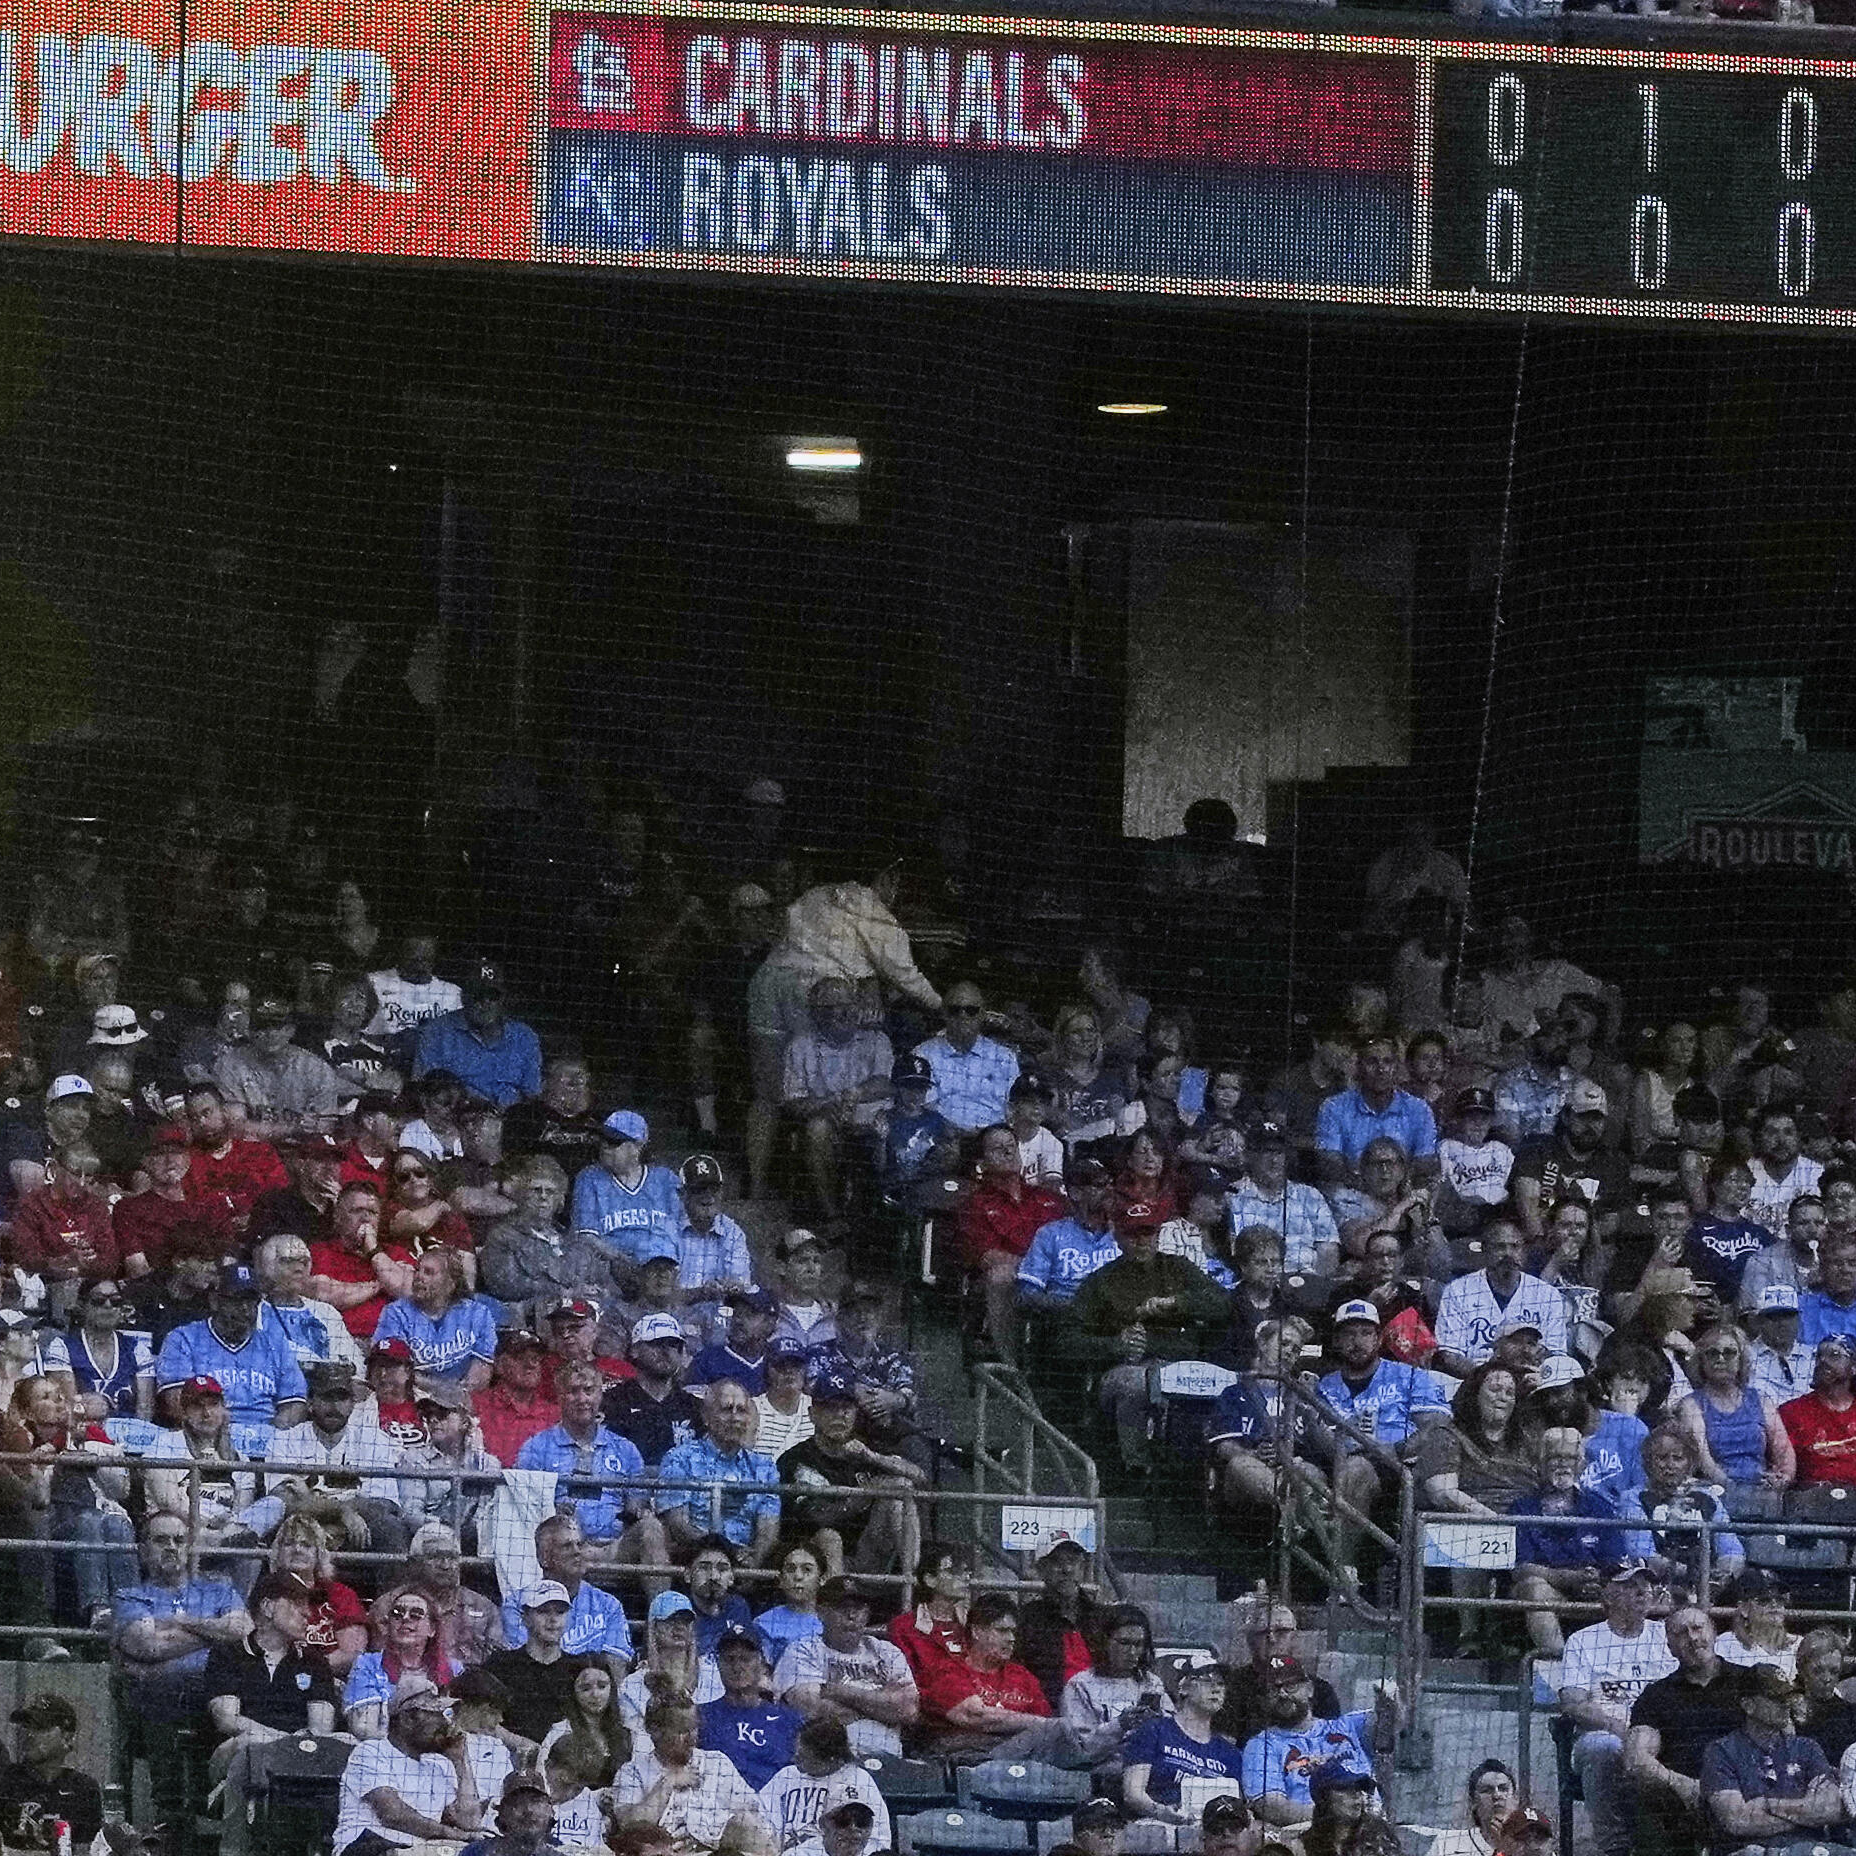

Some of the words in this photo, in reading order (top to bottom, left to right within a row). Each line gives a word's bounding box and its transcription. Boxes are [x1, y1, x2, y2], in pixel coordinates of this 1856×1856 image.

[681, 34, 1088, 149] CARDINALS
[1486, 71, 1525, 166] 0
[1635, 81, 1659, 174] 1
[1779, 86, 1818, 181] 0
[681, 153, 949, 259] ROYALS
[1486, 187, 1524, 284] 0
[1631, 195, 1668, 291] 0
[1776, 202, 1817, 299] 0
[1702, 1234, 1762, 1260] Royals
[413, 1329, 477, 1372] Royals
[1011, 1521, 1040, 1535] 223
[1481, 1541, 1508, 1554] 221
[737, 1722, 766, 1746] KC
